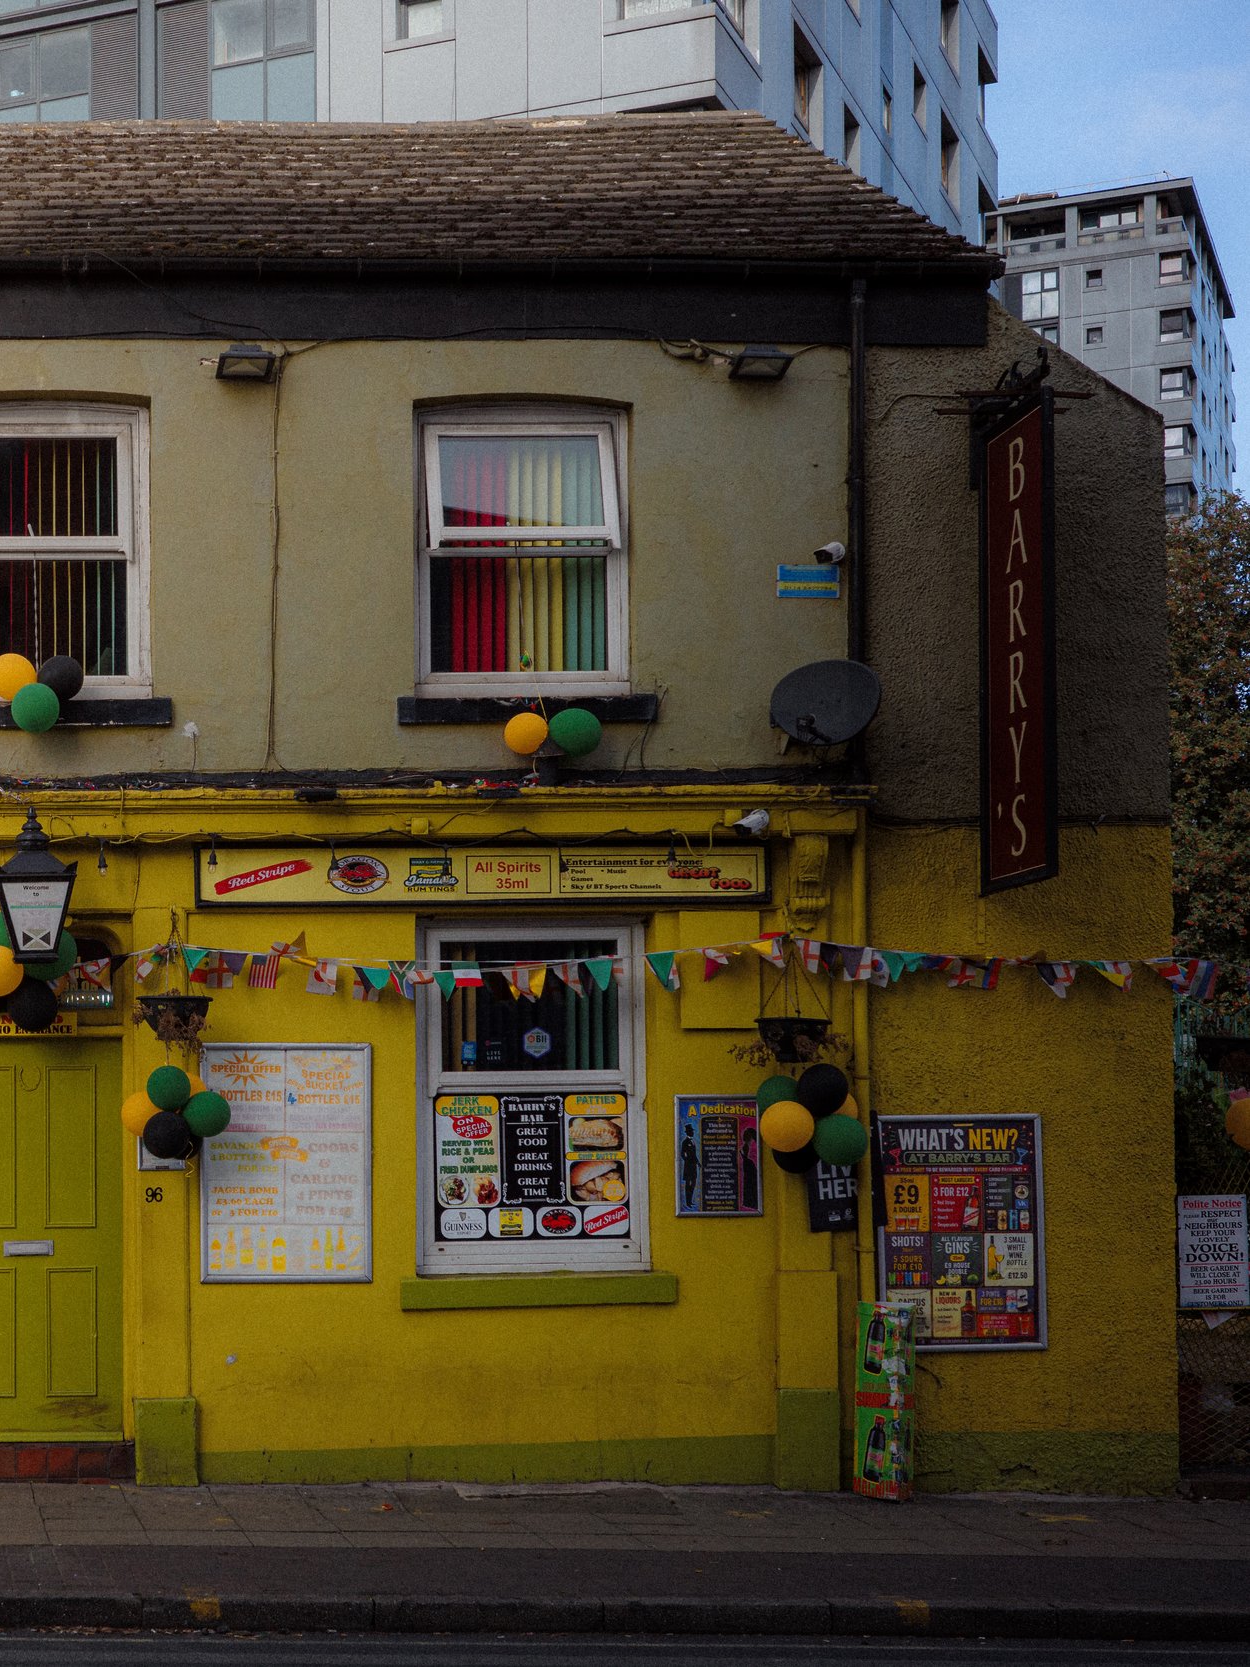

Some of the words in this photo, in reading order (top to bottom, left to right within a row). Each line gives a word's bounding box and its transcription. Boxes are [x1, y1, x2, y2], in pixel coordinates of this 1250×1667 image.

[566, 857, 639, 866] Entertainment
[640, 857, 654, 866] for
[657, 858, 703, 867] evyone:
[475, 861, 493, 873] All
[497, 861, 542, 875] Spirits
[571, 867, 586, 875] Pool
[228, 874, 255, 890] Red
[256, 863, 296, 881] Stripe
[496, 877, 529, 890] 35ml
[571, 883, 584, 891] Sky
[605, 883, 628, 891] Sports
[710, 878, 752, 890] FOOD
[210, 1064, 250, 1073] SPECIAL
[252, 1064, 282, 1073] OFFER
[219, 1090, 262, 1102] BOTTLES
[297, 1094, 340, 1105] BOTTLES
[576, 1096, 617, 1105] PATTIES
[451, 1097, 479, 1106] JERK
[441, 1106, 492, 1116] CHICKEN
[508, 1103, 556, 1112] BARRY'S
[687, 1103, 697, 1117] A
[699, 1103, 757, 1117] Dedication
[456, 1116, 474, 1126] ON
[520, 1114, 544, 1122] BAR
[456, 1121, 491, 1135] SPECIAL
[465, 1127, 489, 1138] OFFER
[516, 1127, 549, 1136] GREAT
[518, 1138, 548, 1146] FOOD
[897, 1128, 964, 1151] WHAT'S
[968, 1128, 1019, 1150] NEW?
[442, 1148, 461, 1156] RICE
[463, 1148, 471, 1156] &
[472, 1147, 495, 1155] PEAS
[516, 1152, 549, 1160] GREAT
[462, 1156, 475, 1164] OR
[909, 1153, 925, 1163] AT
[928, 1152, 981, 1163] BARRY'S
[985, 1152, 1011, 1162] BAR
[439, 1166, 459, 1174] FRIED
[459, 1165, 498, 1174] DUMPLINGS
[514, 1162, 553, 1172] DRINKS
[517, 1177, 550, 1186] GREAT
[145, 1187, 163, 1203] 96
[210, 1186, 246, 1195] JAGER
[249, 1186, 279, 1195] BOMB
[522, 1187, 548, 1196] TIME
[893, 1185, 919, 1204] £9
[933, 1188, 938, 1197] 3
[940, 1187, 955, 1197] FOR
[956, 1187, 969, 1197] £12
[1182, 1199, 1209, 1209] Polite
[1211, 1199, 1242, 1209] Notice
[238, 1208, 260, 1217] FOR
[1201, 1210, 1242, 1219] RESPECT
[585, 1220, 602, 1232] Red
[603, 1209, 627, 1225] Stripe
[1184, 1221, 1243, 1230] NEIGHBOURS
[443, 1221, 482, 1231] GUINNESS
[1190, 1229, 1212, 1237] KEEP
[891, 1235, 924, 1248] SHOTS!
[944, 1242, 970, 1254] GINS
[1189, 1243, 1239, 1254] VOICE
[1185, 1252, 1244, 1263] DOWN!
[935, 1297, 961, 1305] LIQUORS
